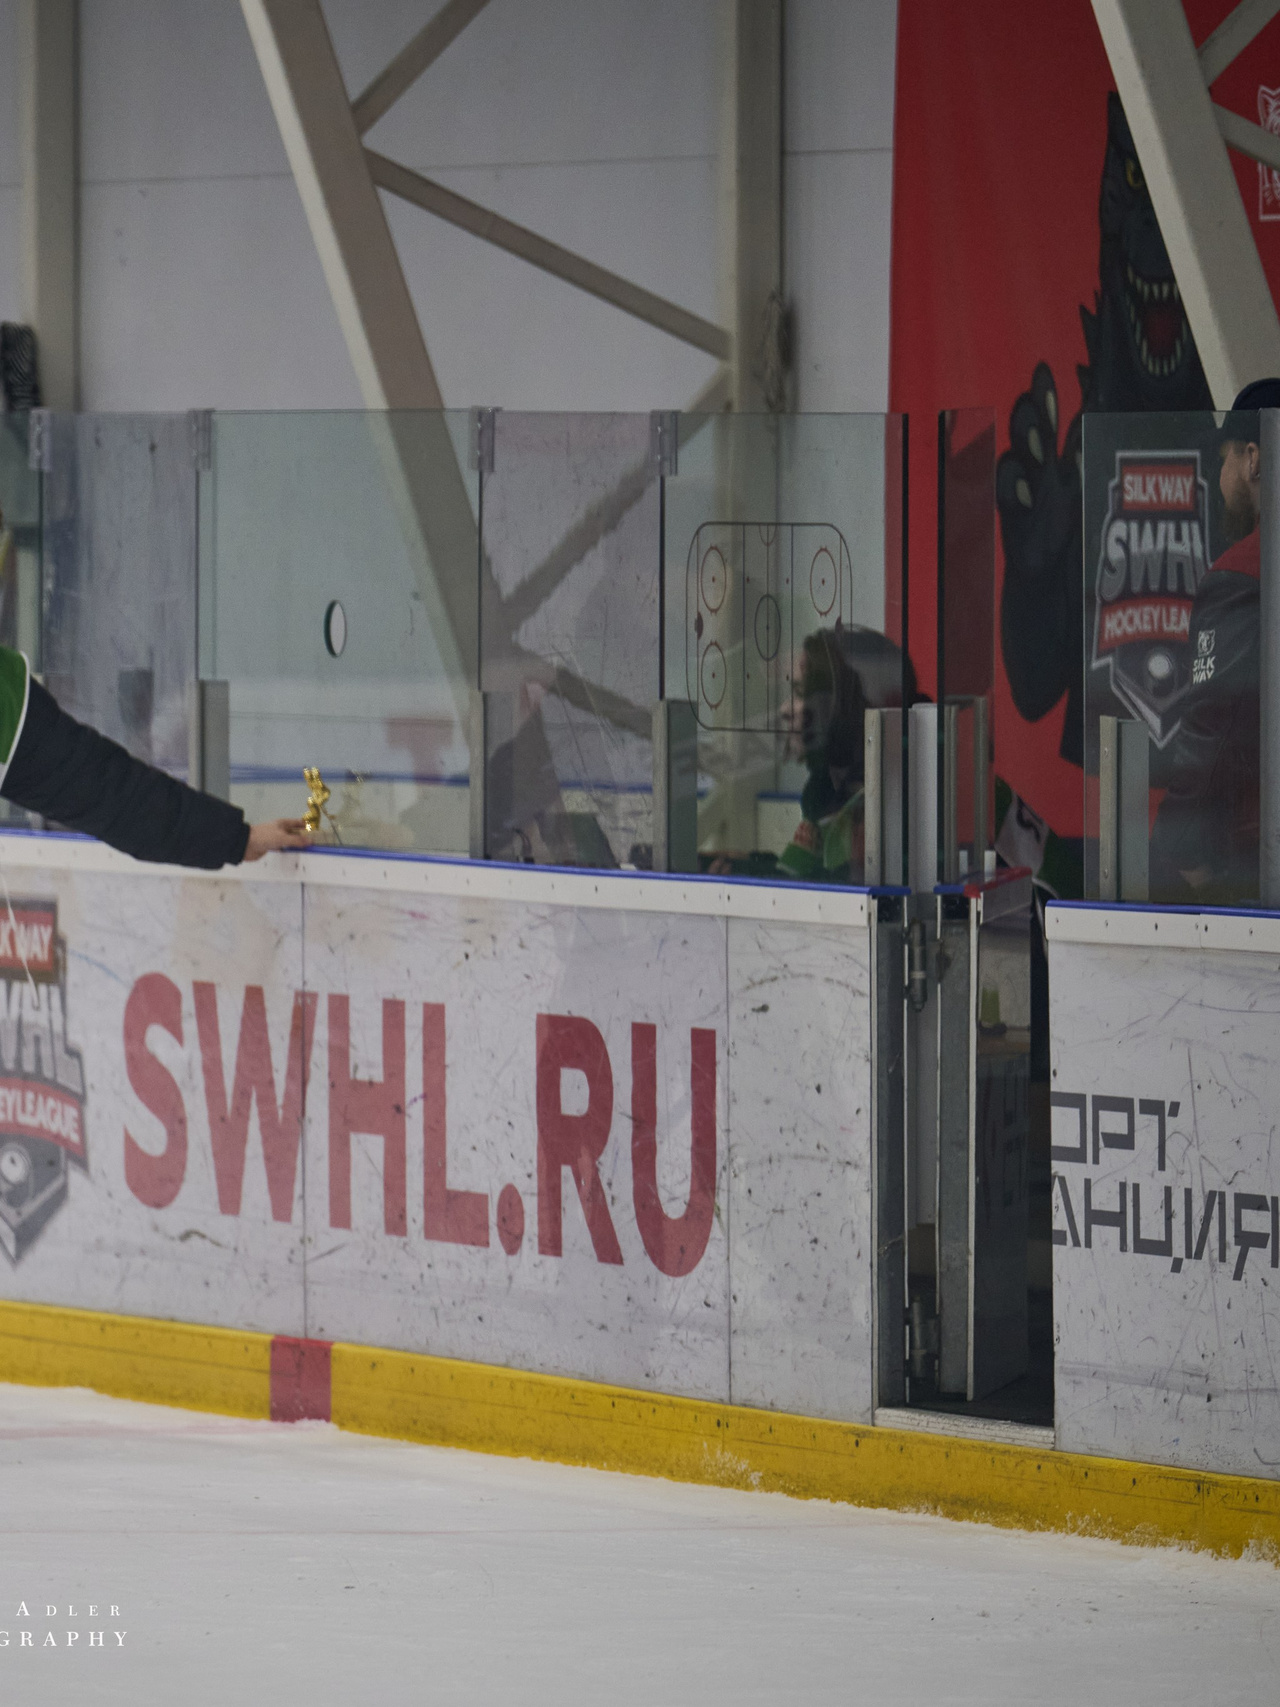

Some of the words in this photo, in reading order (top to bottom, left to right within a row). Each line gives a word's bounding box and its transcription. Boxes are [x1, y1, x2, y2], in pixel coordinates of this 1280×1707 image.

[1123, 474, 1157, 503] SILK
[1158, 475, 1193, 505] WAY
[1104, 605, 1160, 640] HOCKEY
[1162, 606, 1190, 634] LEA
[1193, 656, 1216, 671] SILK
[1193, 670, 1214, 684] WAY
[15, 920, 53, 962] WAY
[17, 1088, 80, 1144] LEAGUE
[123, 972, 717, 1277] SWHL.RU
